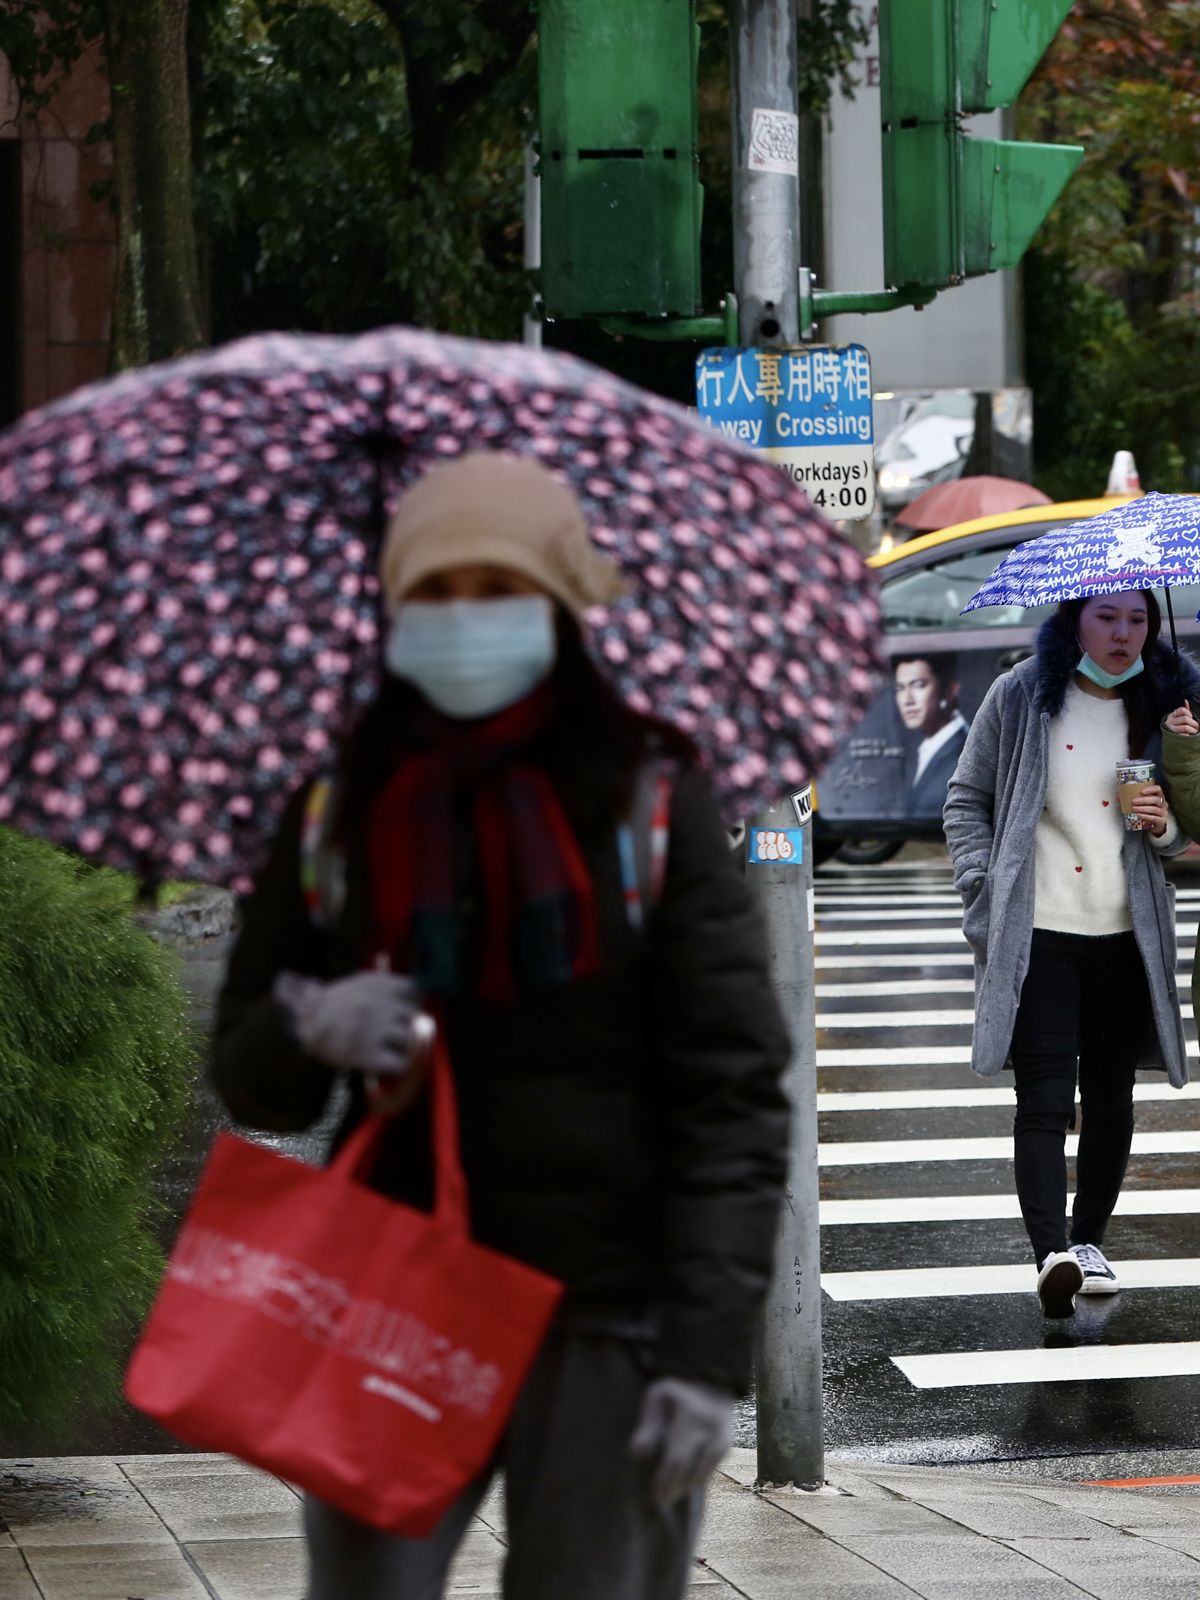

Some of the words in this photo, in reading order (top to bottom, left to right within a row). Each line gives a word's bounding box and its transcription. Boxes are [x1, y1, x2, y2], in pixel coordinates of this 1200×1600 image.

[696, 349, 870, 407] 行人專用時相
[775, 411, 871, 440] Crossing
[804, 487, 867, 508] 4:00
[1083, 578, 1141, 597] THAVASA
